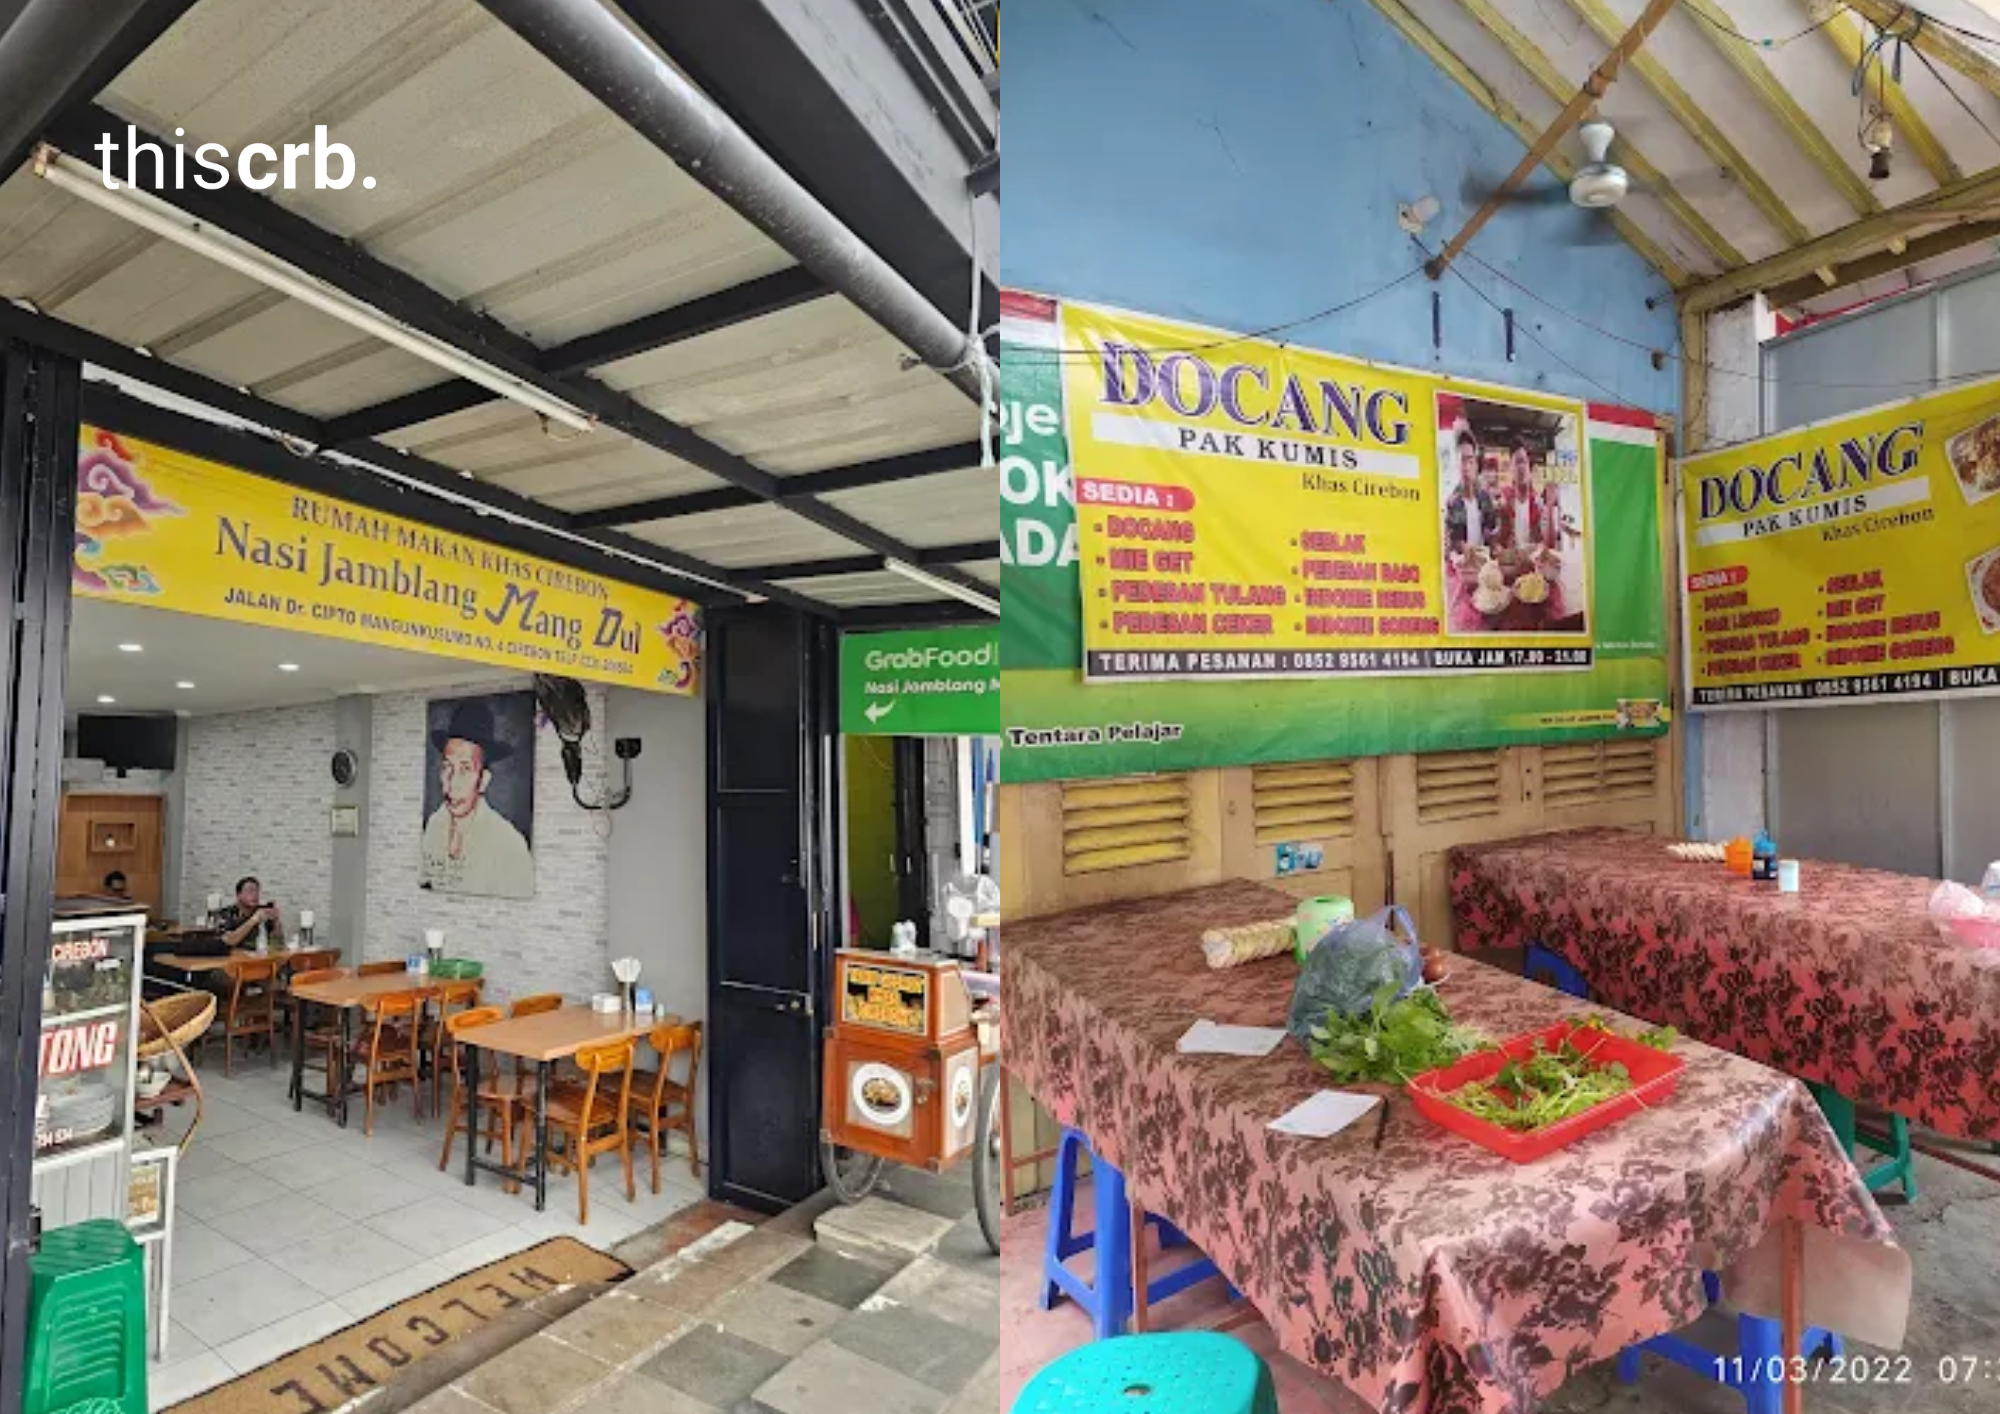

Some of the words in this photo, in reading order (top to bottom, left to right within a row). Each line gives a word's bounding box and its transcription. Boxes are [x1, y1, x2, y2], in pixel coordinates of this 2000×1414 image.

[1100, 341, 1411, 444] DOCANG
[1178, 427, 1245, 457] PAK
[1257, 440, 1359, 470] KUMIS
[1699, 422, 1924, 520] DOCANG
[1082, 481, 1160, 506] SEDIA
[1302, 472, 1348, 496] Khas
[1352, 478, 1421, 502] Cirebon
[1107, 515, 1195, 543] DOCANG
[1742, 513, 1782, 538] PAK
[1789, 495, 1868, 527] KUMIS
[1821, 520, 1862, 542] Khas
[1865, 507, 1936, 536] Cirebon
[292, 496, 390, 543] RUMAH
[397, 525, 475, 567] MAKAN
[481, 551, 532, 581] KHAS
[1153, 551, 1194, 573] GET
[216, 515, 308, 574] Nasi
[319, 542, 478, 621] Jamblang
[485, 582, 583, 651] Mang
[592, 607, 642, 654] Dul
[1210, 583, 1287, 606] TULANG
[224, 588, 281, 612] JALAN
[312, 603, 356, 625] CIPTO
[865, 642, 991, 670] GrabFood
[1100, 652, 1180, 672] TERIMA
[1187, 651, 1276, 670] PESANAN
[1293, 652, 1335, 669] 0852
[1434, 649, 1474, 666] BUKA
[1477, 649, 1505, 665] JAM
[865, 680, 899, 694] Nasi
[902, 677, 987, 696] Jamblang
[1950, 667, 1998, 685] BUKA
[1008, 727, 1102, 747] Tentara
[1107, 722, 1183, 743] Pelajar
[52, 939, 110, 961] CIREBON
[270, 1266, 560, 1414] WELCOME
